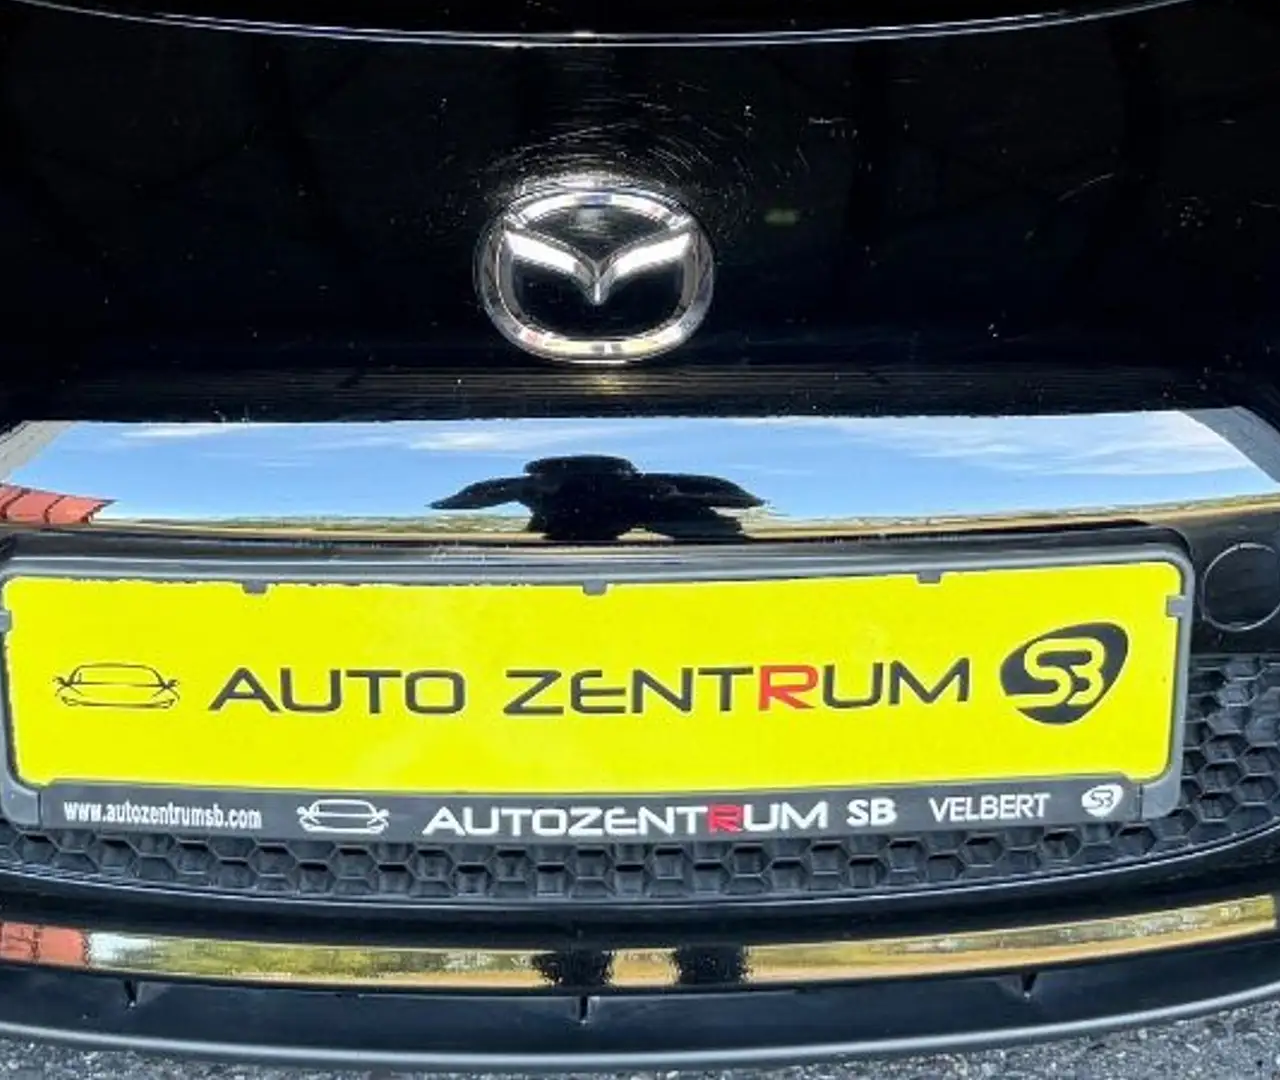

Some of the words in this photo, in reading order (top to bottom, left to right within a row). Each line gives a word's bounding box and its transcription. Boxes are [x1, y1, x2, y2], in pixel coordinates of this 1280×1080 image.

[207, 666, 466, 715] AUTO
[502, 657, 970, 715] ZENTRUM
[63, 799, 263, 831] www.autozentrumsb.com
[421, 800, 829, 837] AUTOZENTRUM
[846, 797, 899, 827] SB
[928, 792, 1051, 823] VELBERT
